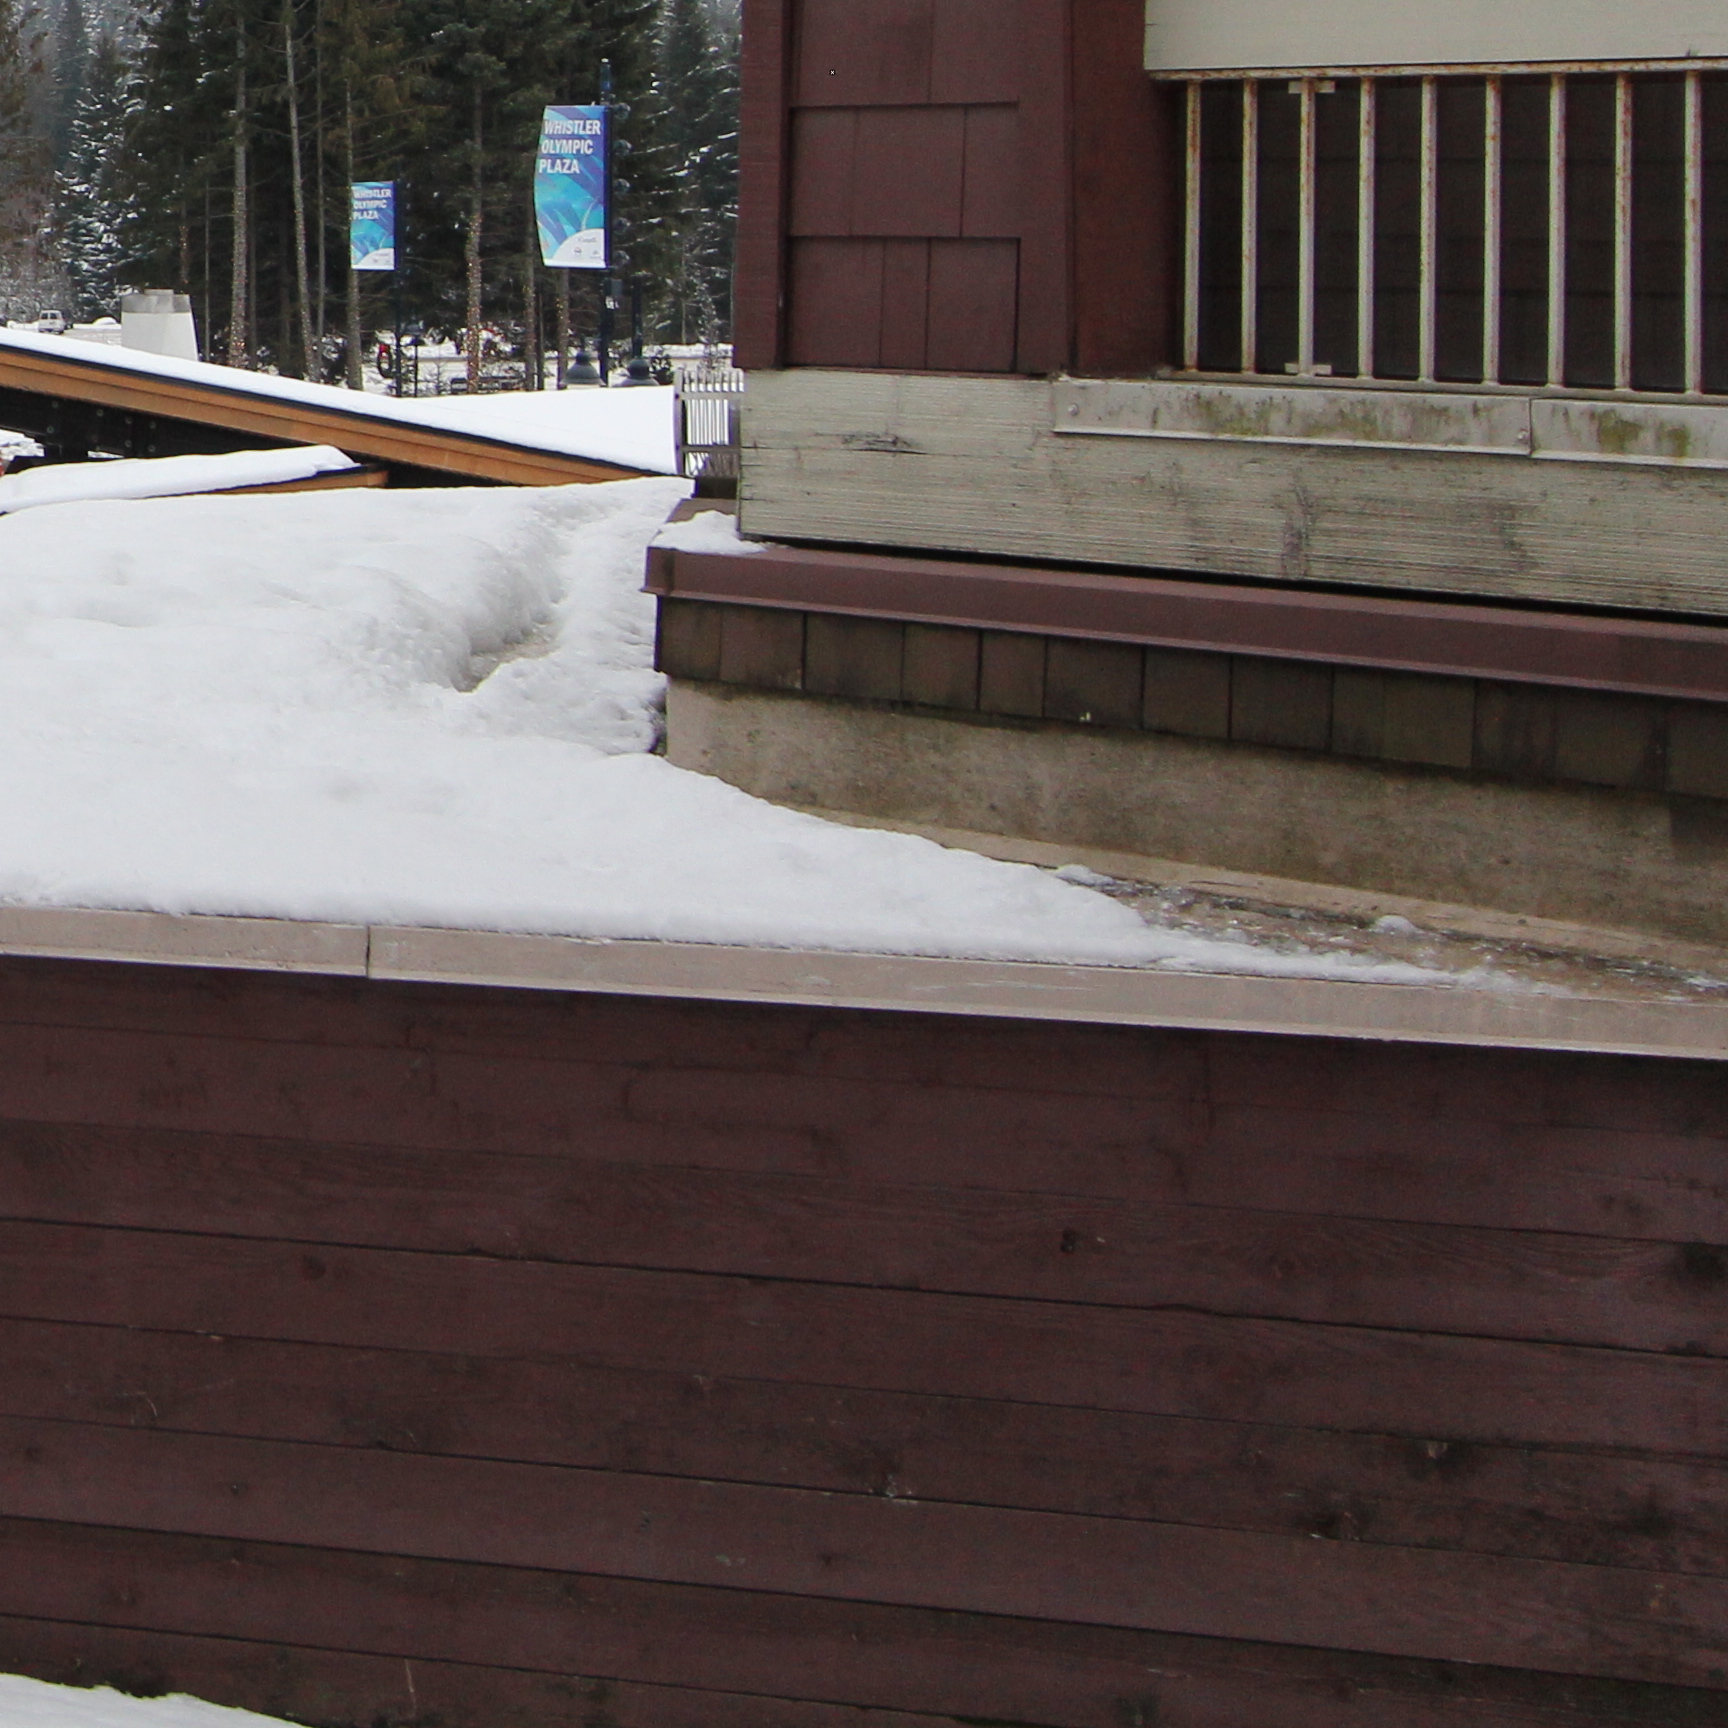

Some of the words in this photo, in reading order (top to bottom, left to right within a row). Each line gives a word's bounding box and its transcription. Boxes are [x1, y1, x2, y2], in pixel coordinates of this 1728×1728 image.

[543, 119, 601, 135] WHISTLER
[541, 139, 594, 154] OLYMPIC
[539, 159, 580, 174] PLAZA
[353, 210, 379, 220] PLAZA
